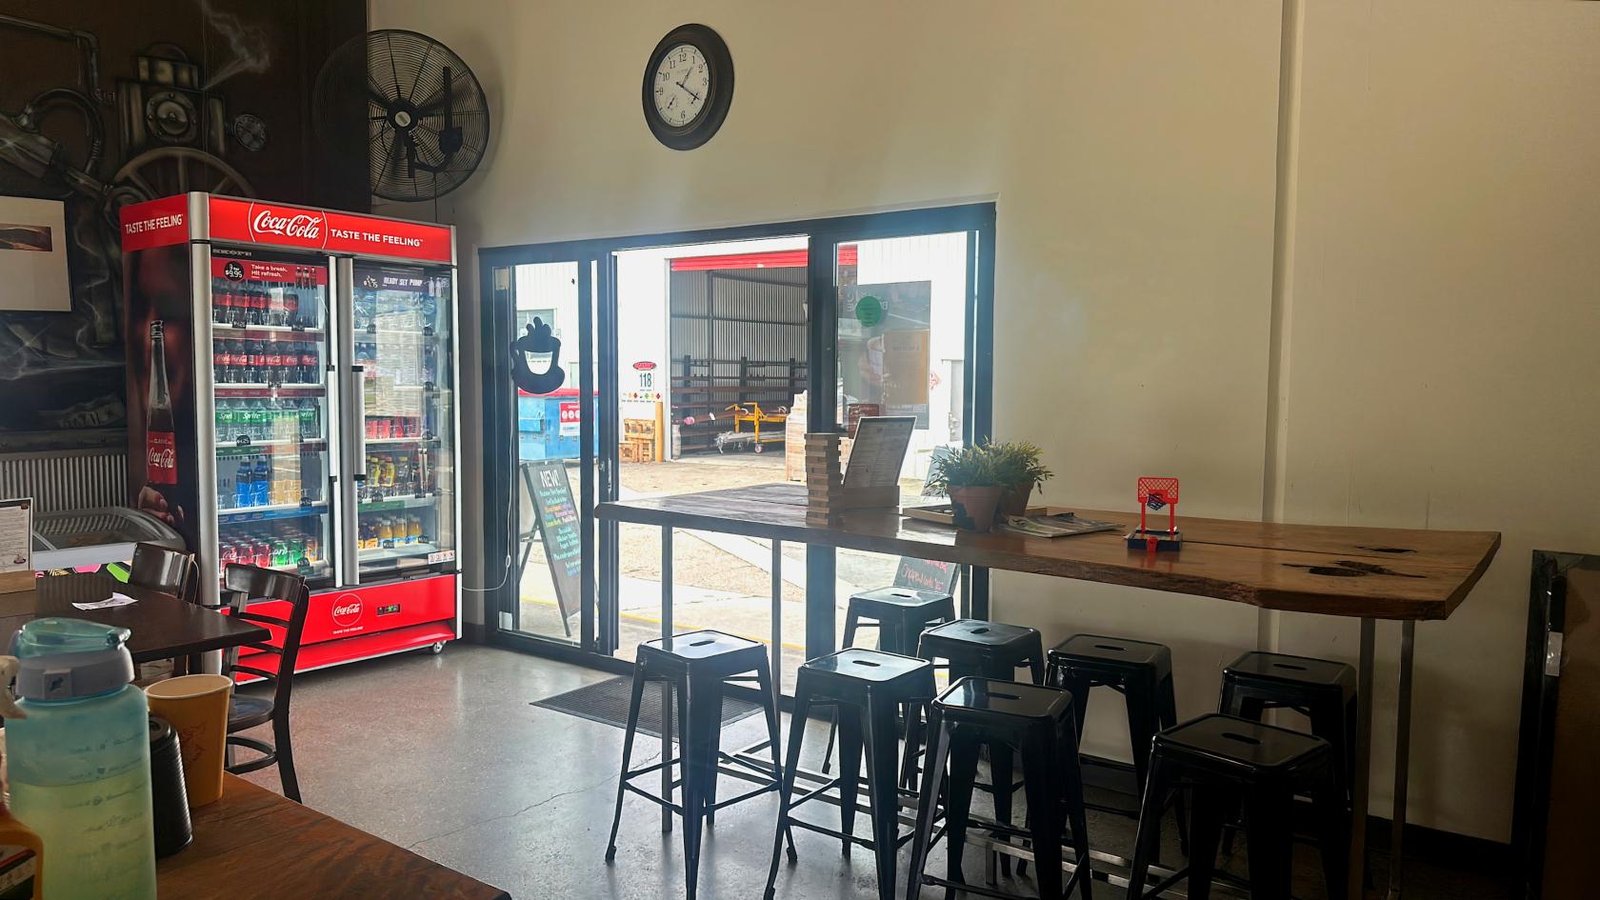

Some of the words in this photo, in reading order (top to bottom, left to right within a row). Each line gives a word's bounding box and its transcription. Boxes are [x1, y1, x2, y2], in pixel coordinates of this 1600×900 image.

[679, 52, 687, 63] 12
[669, 60, 676, 70] 11
[698, 64, 704, 74] 2
[662, 72, 670, 82] 10
[702, 78, 708, 87] 3
[658, 86, 664, 96] 9
[680, 110, 686, 119] 6
[125, 222, 143, 235] TASTE
[143, 220, 156, 232] THE
[155, 213, 183, 229] FEELING
[253, 210, 322, 240] Coca-Cola
[330, 228, 360, 240] TASTE
[362, 232, 381, 243] THE
[383, 235, 421, 247] FEELING
[640, 372, 652, 387] 118
[539, 469, 561, 488] NEW!
